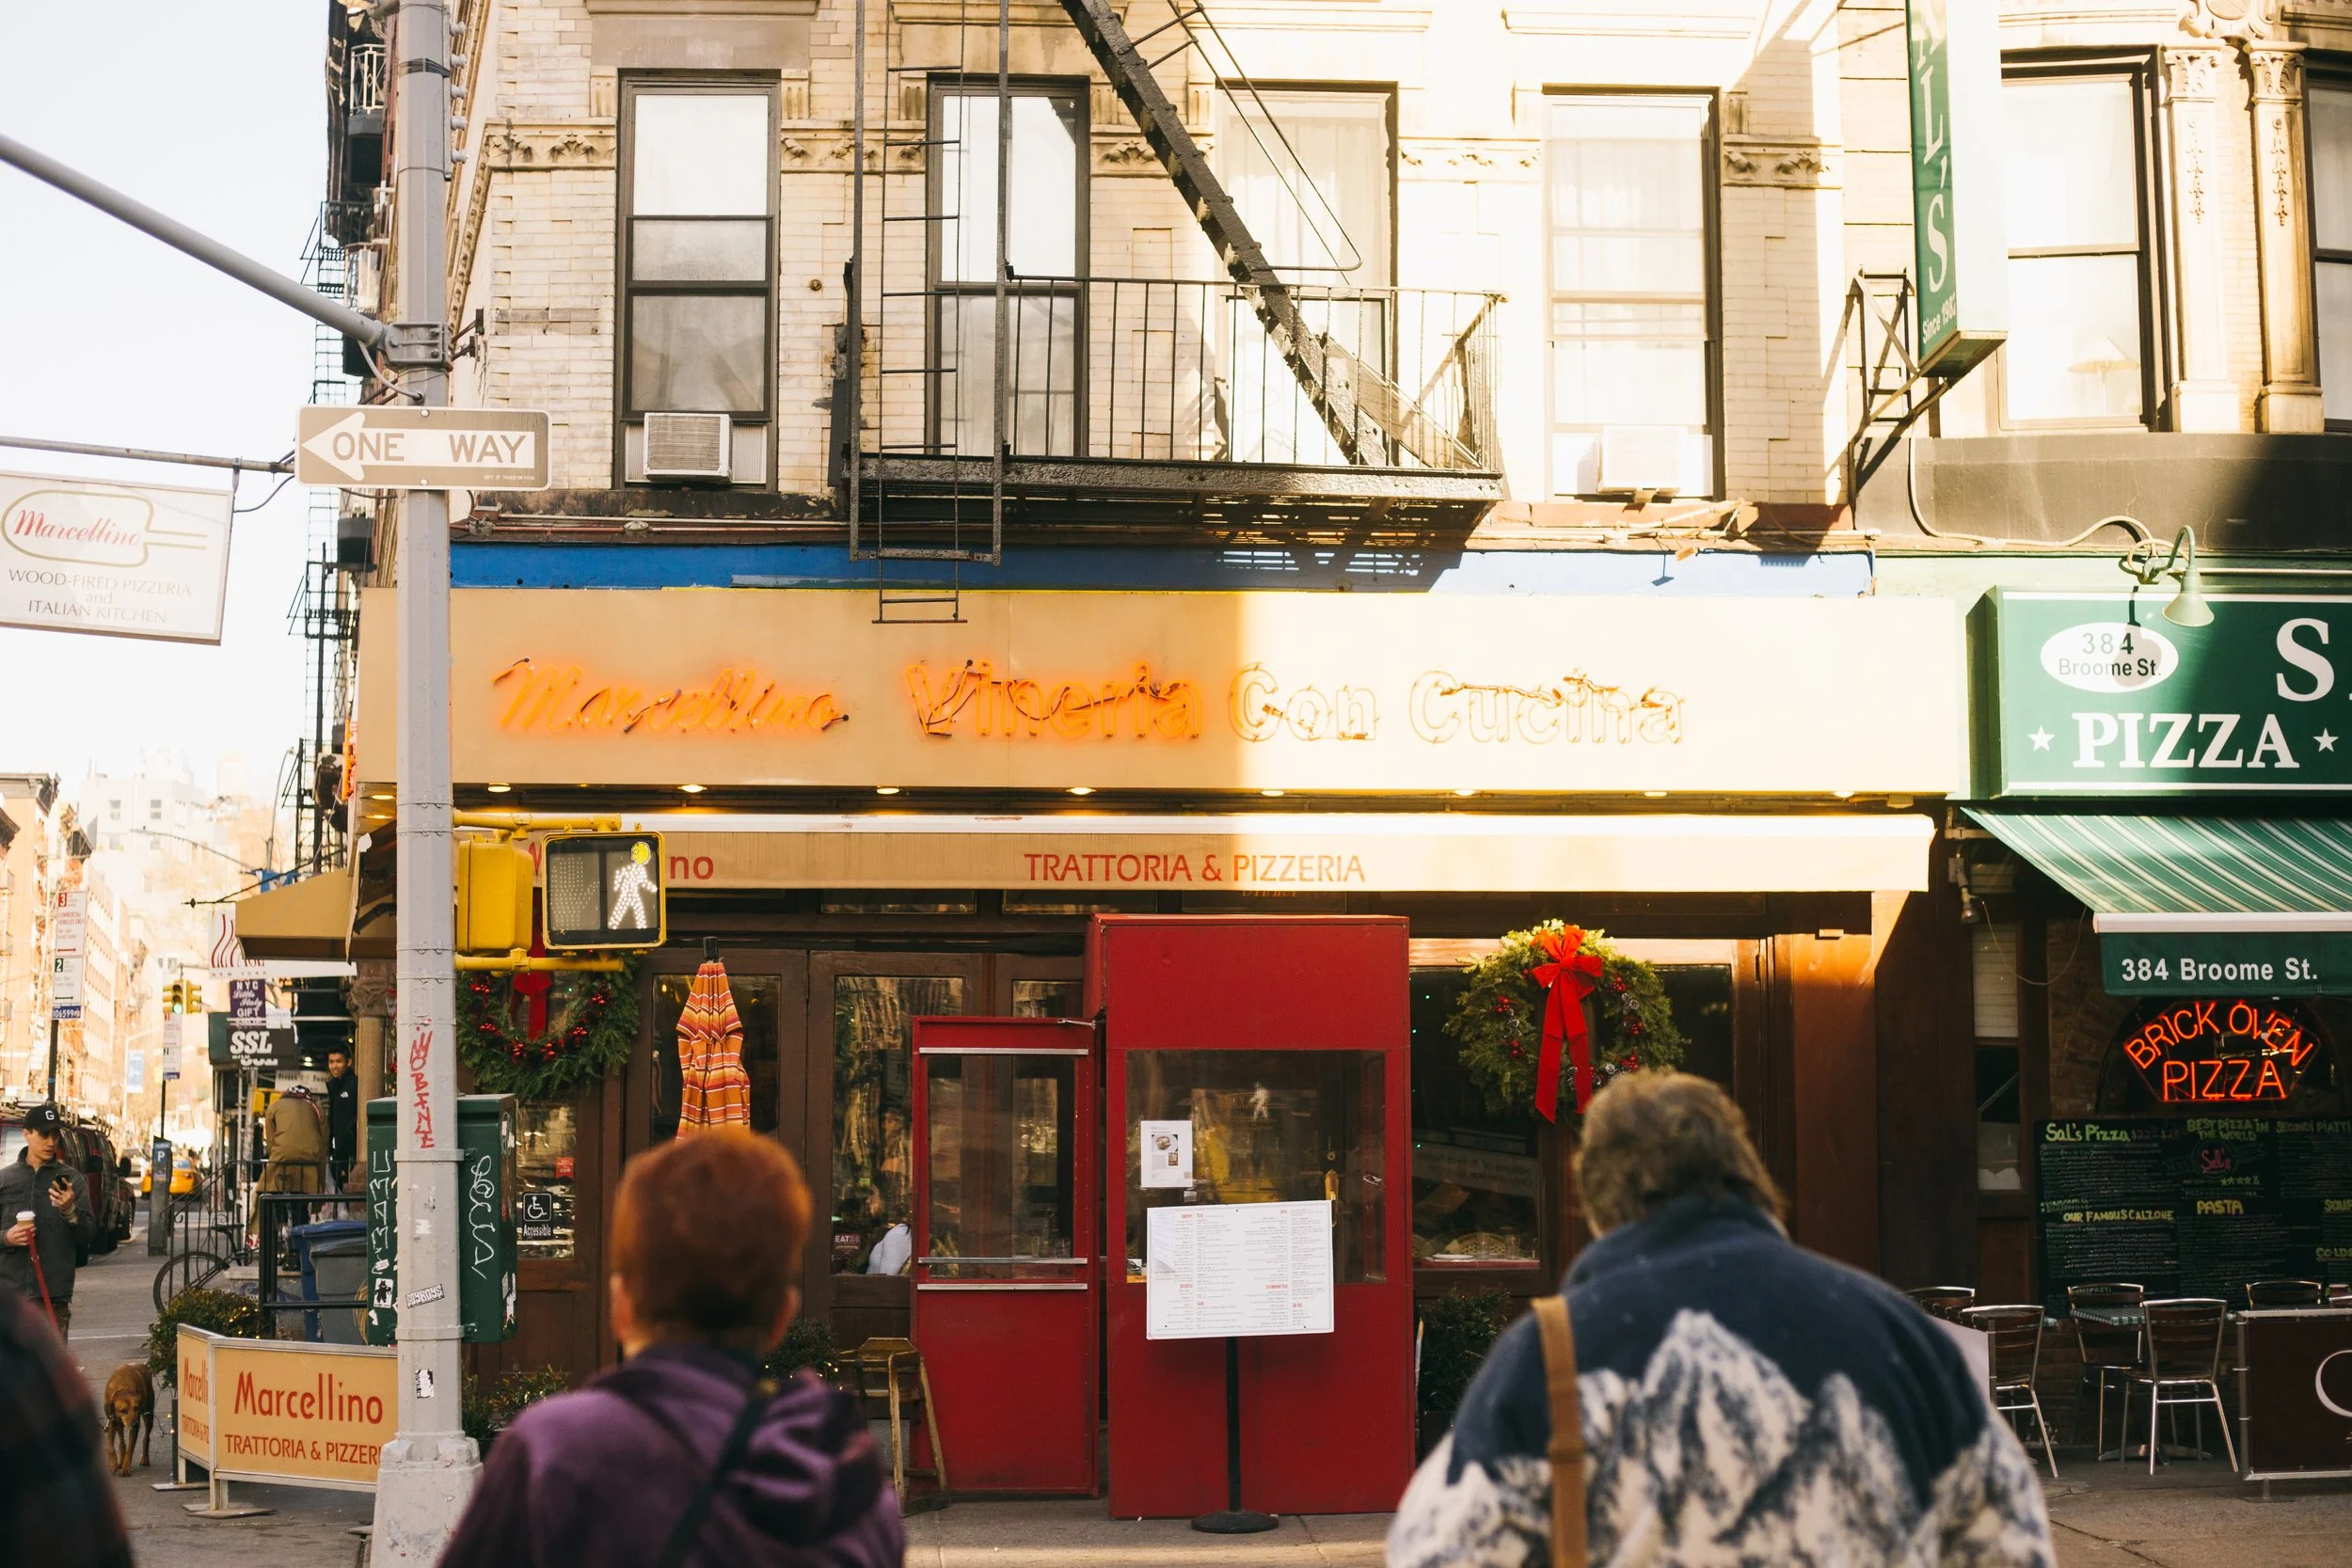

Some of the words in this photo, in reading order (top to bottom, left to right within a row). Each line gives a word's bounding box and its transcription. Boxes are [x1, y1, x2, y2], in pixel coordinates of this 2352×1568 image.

[1923, 314, 1940, 344] Since
[333, 432, 405, 461] ONE
[449, 435, 526, 464] WAY
[13, 509, 142, 546] Marcellino
[9, 568, 118, 591] WOOD-FIRED
[122, 578, 192, 596] PIZZERIA
[85, 592, 113, 605] and
[28, 599, 90, 617] ITALIAN
[97, 605, 166, 624] KITCHEN
[2082, 632, 2135, 656] 384
[2058, 657, 2133, 676] Broome
[2137, 657, 2162, 676] St.
[493, 659, 839, 733] Marcellino
[906, 659, 1202, 736] Vineria
[1229, 662, 1379, 743] Con
[1411, 667, 1686, 745] Cucina
[2072, 712, 2300, 768] PIZZA
[1024, 853, 1192, 882] TRATTORIA
[1201, 854, 1224, 882] &
[1233, 854, 1367, 882] PIZZERIA
[2122, 958, 2169, 982] 384
[2180, 958, 2274, 981] Broome
[2284, 957, 2318, 981] St.
[236, 980, 259, 990] NYC
[236, 1007, 259, 1018] GIFT
[230, 1030, 273, 1054] SSL
[2123, 1001, 2221, 1069] BRICK
[2229, 1000, 2313, 1067] OVEN
[2163, 1059, 2287, 1102] PIZZA
[2045, 1122, 2083, 1143] Sal's
[2186, 1118, 2217, 1132] BEST
[2198, 1131, 2217, 1141] THE
[2219, 1131, 2257, 1141] WORLD
[157, 1150, 166, 1163] P
[2062, 1212, 2084, 1223] OUR
[2086, 1209, 2128, 1223] FAMOUS
[2128, 1209, 2175, 1222] CALZONE
[2196, 1199, 2244, 1215] PASTA
[523, 1224, 551, 1237] Accessible
[233, 1370, 383, 1425] Marcellino
[224, 1433, 307, 1460] TRATTORIA
[310, 1441, 322, 1461] &
